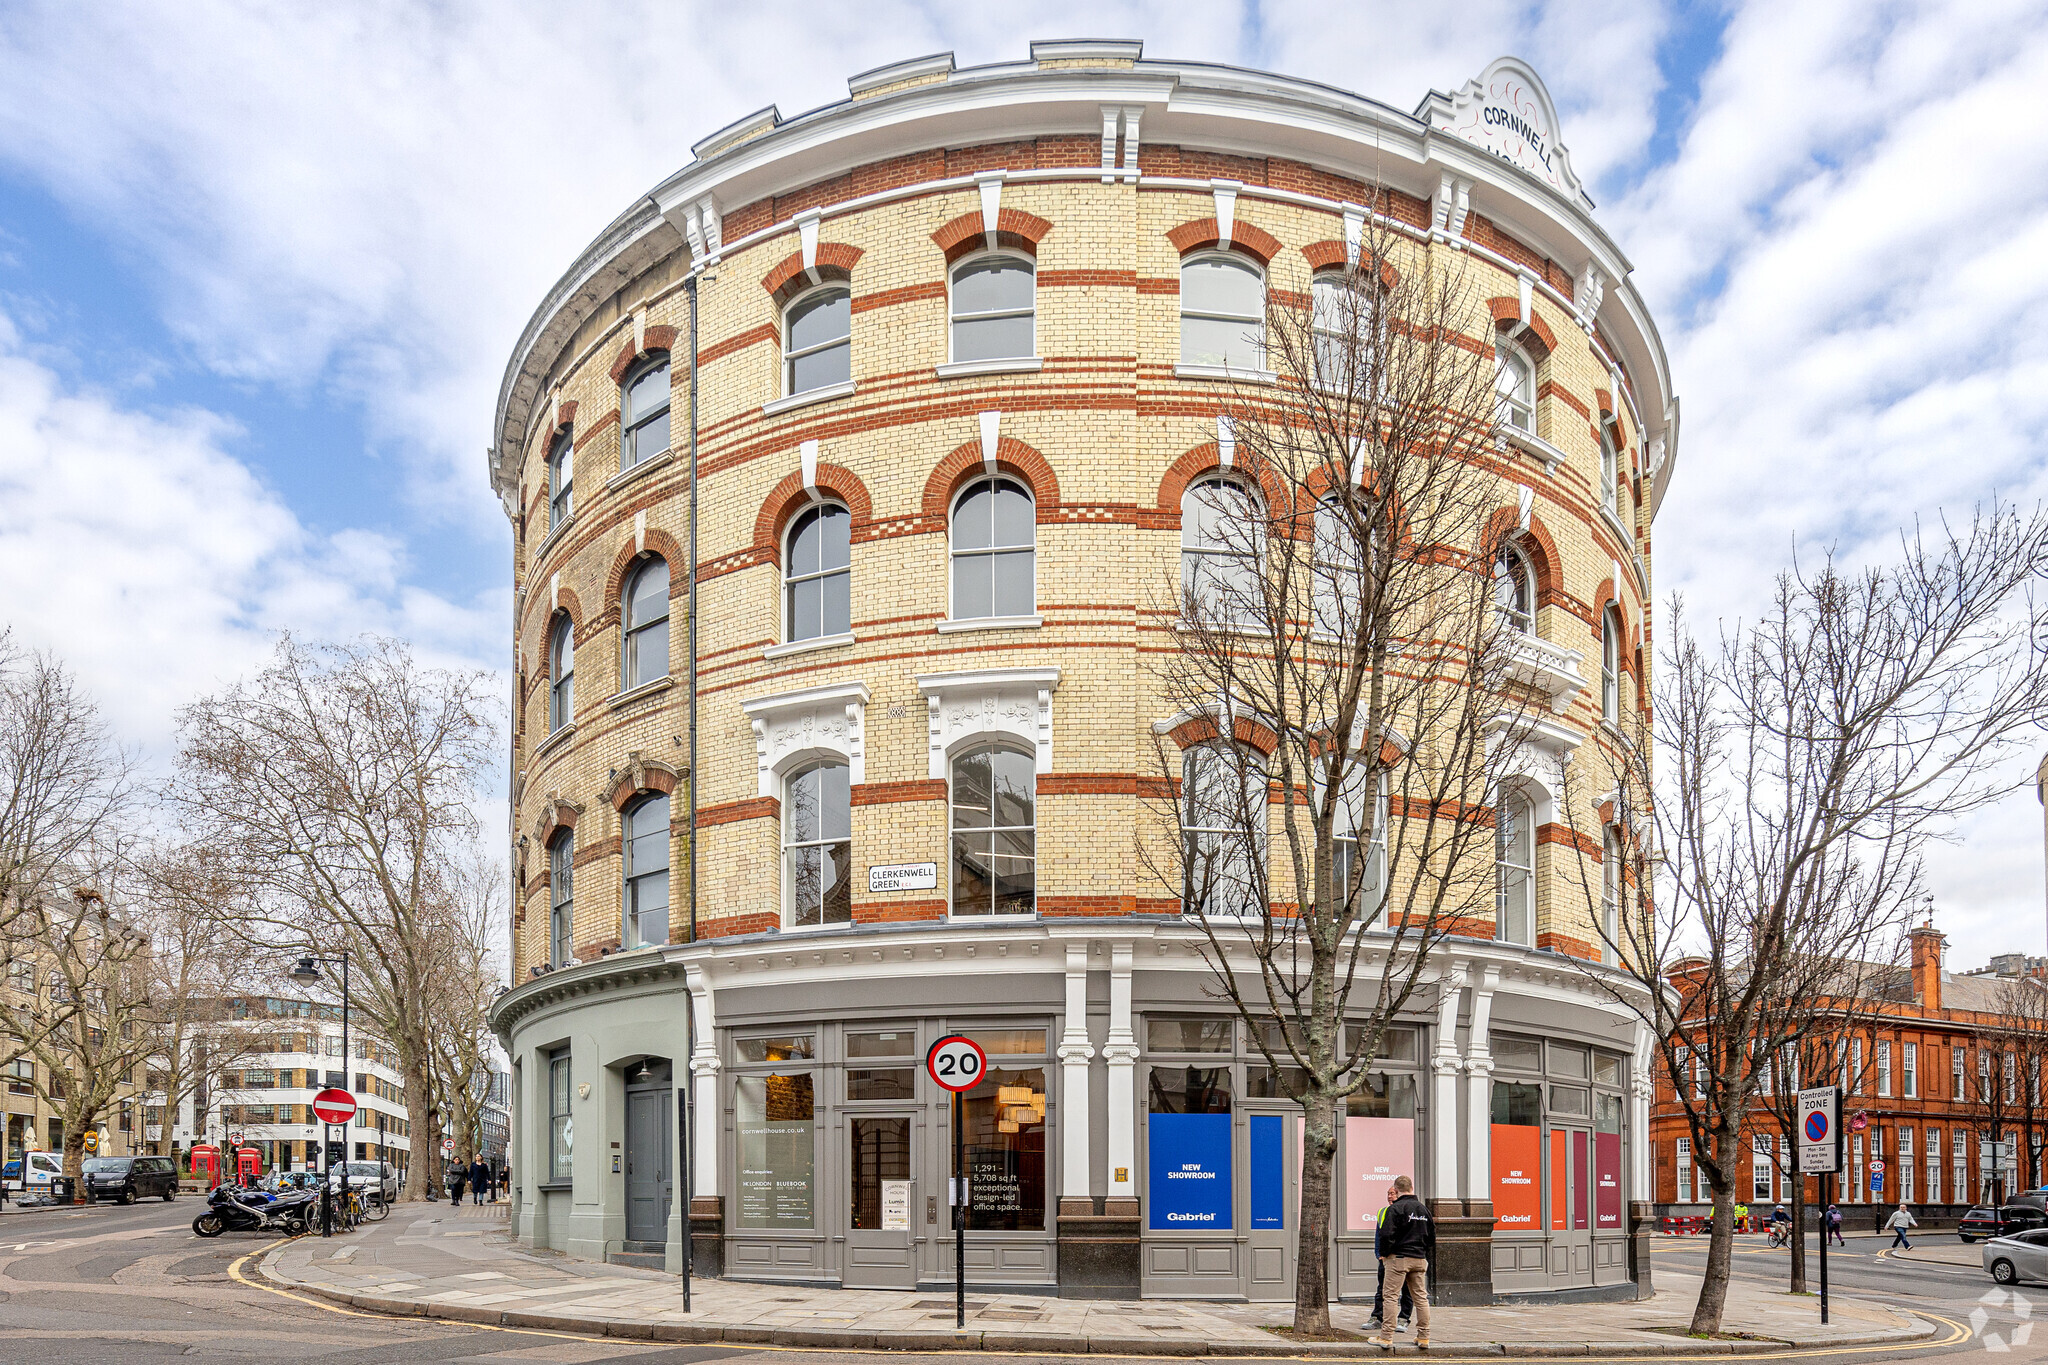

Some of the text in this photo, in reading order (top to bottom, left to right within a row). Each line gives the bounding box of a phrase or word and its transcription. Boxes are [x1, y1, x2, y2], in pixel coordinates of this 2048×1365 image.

[1484, 106, 1552, 173] CORNWELL
[872, 868, 934, 879] CLERKENWELL
[872, 880, 900, 889] GREEN
[938, 1052, 979, 1075] 20
[1800, 1089, 1833, 1100] Controlled
[1805, 1099, 1828, 1109] ZONE
[741, 1127, 805, 1135] cornwellhouse.co.uk
[973, 1184, 1020, 1192] exceptional
[973, 1193, 1016, 1202] design-led
[973, 1203, 1023, 1212] office space.
[1167, 1212, 1216, 1221] Gabriel
